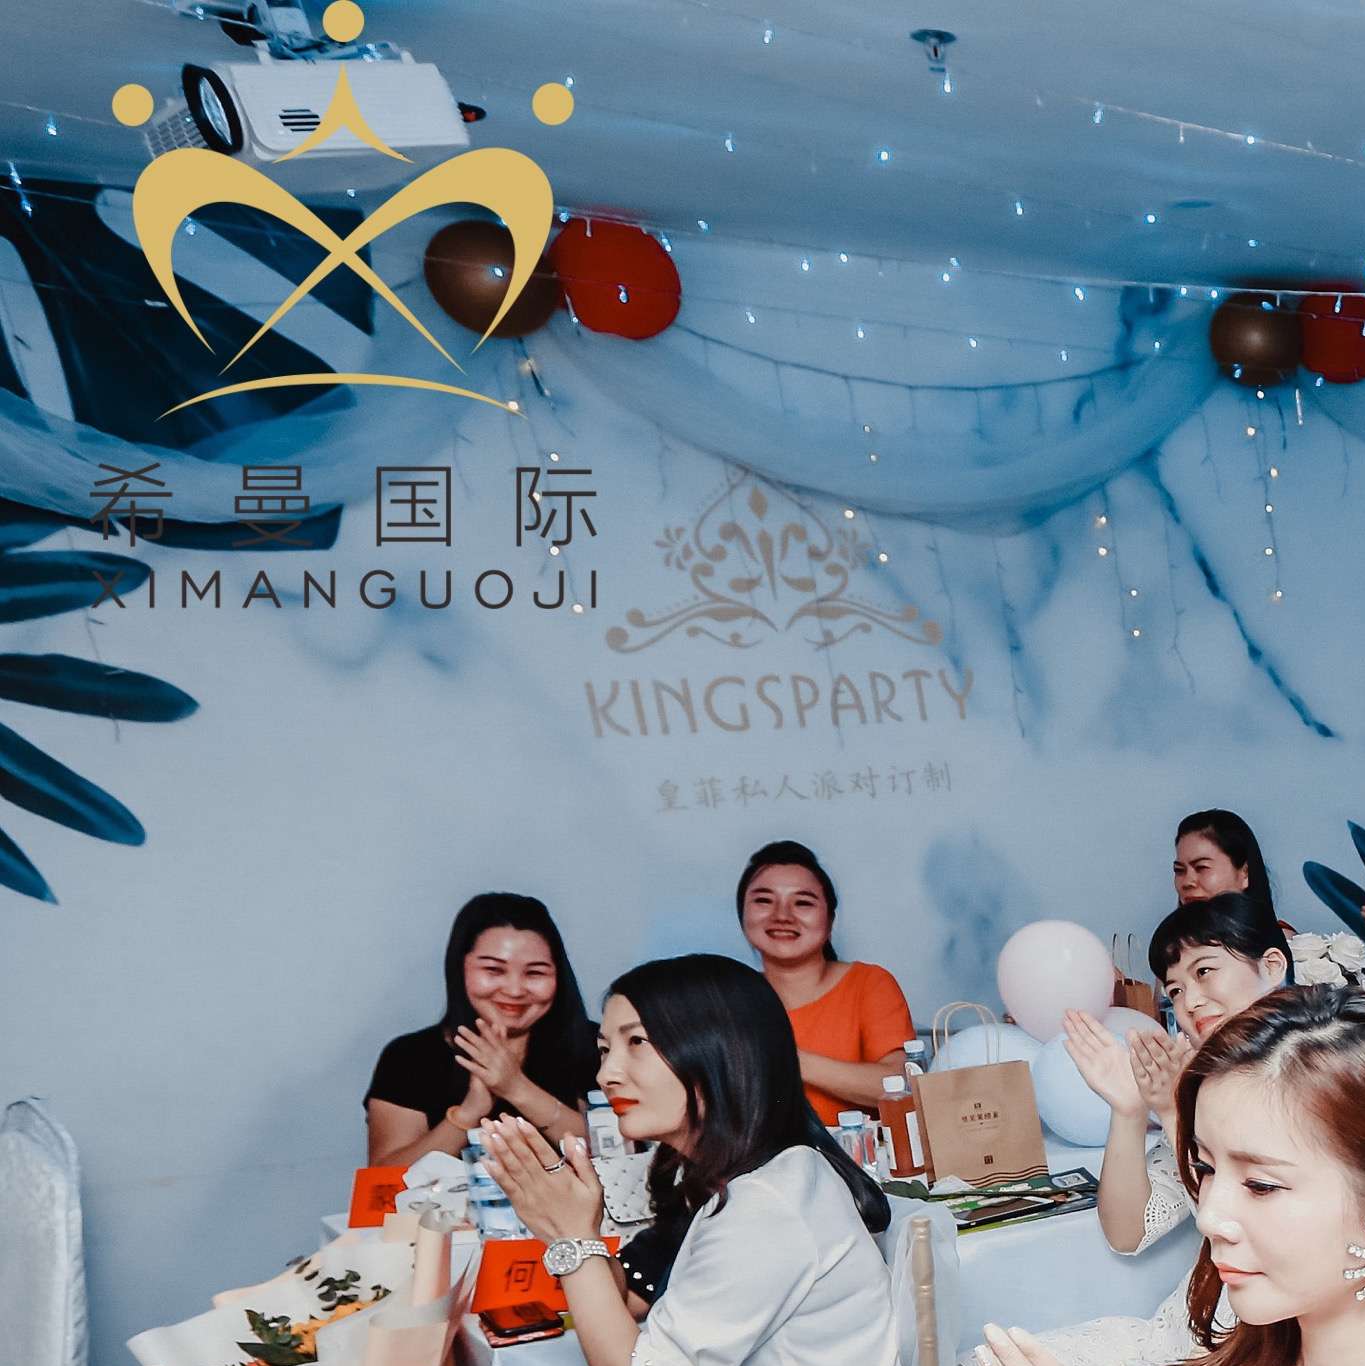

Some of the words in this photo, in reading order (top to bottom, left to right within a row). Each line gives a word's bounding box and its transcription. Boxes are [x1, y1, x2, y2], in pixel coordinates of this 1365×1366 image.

[585, 667, 973, 737] KINGSPARTY
[656, 761, 953, 813] 皇菲私人派对订制
